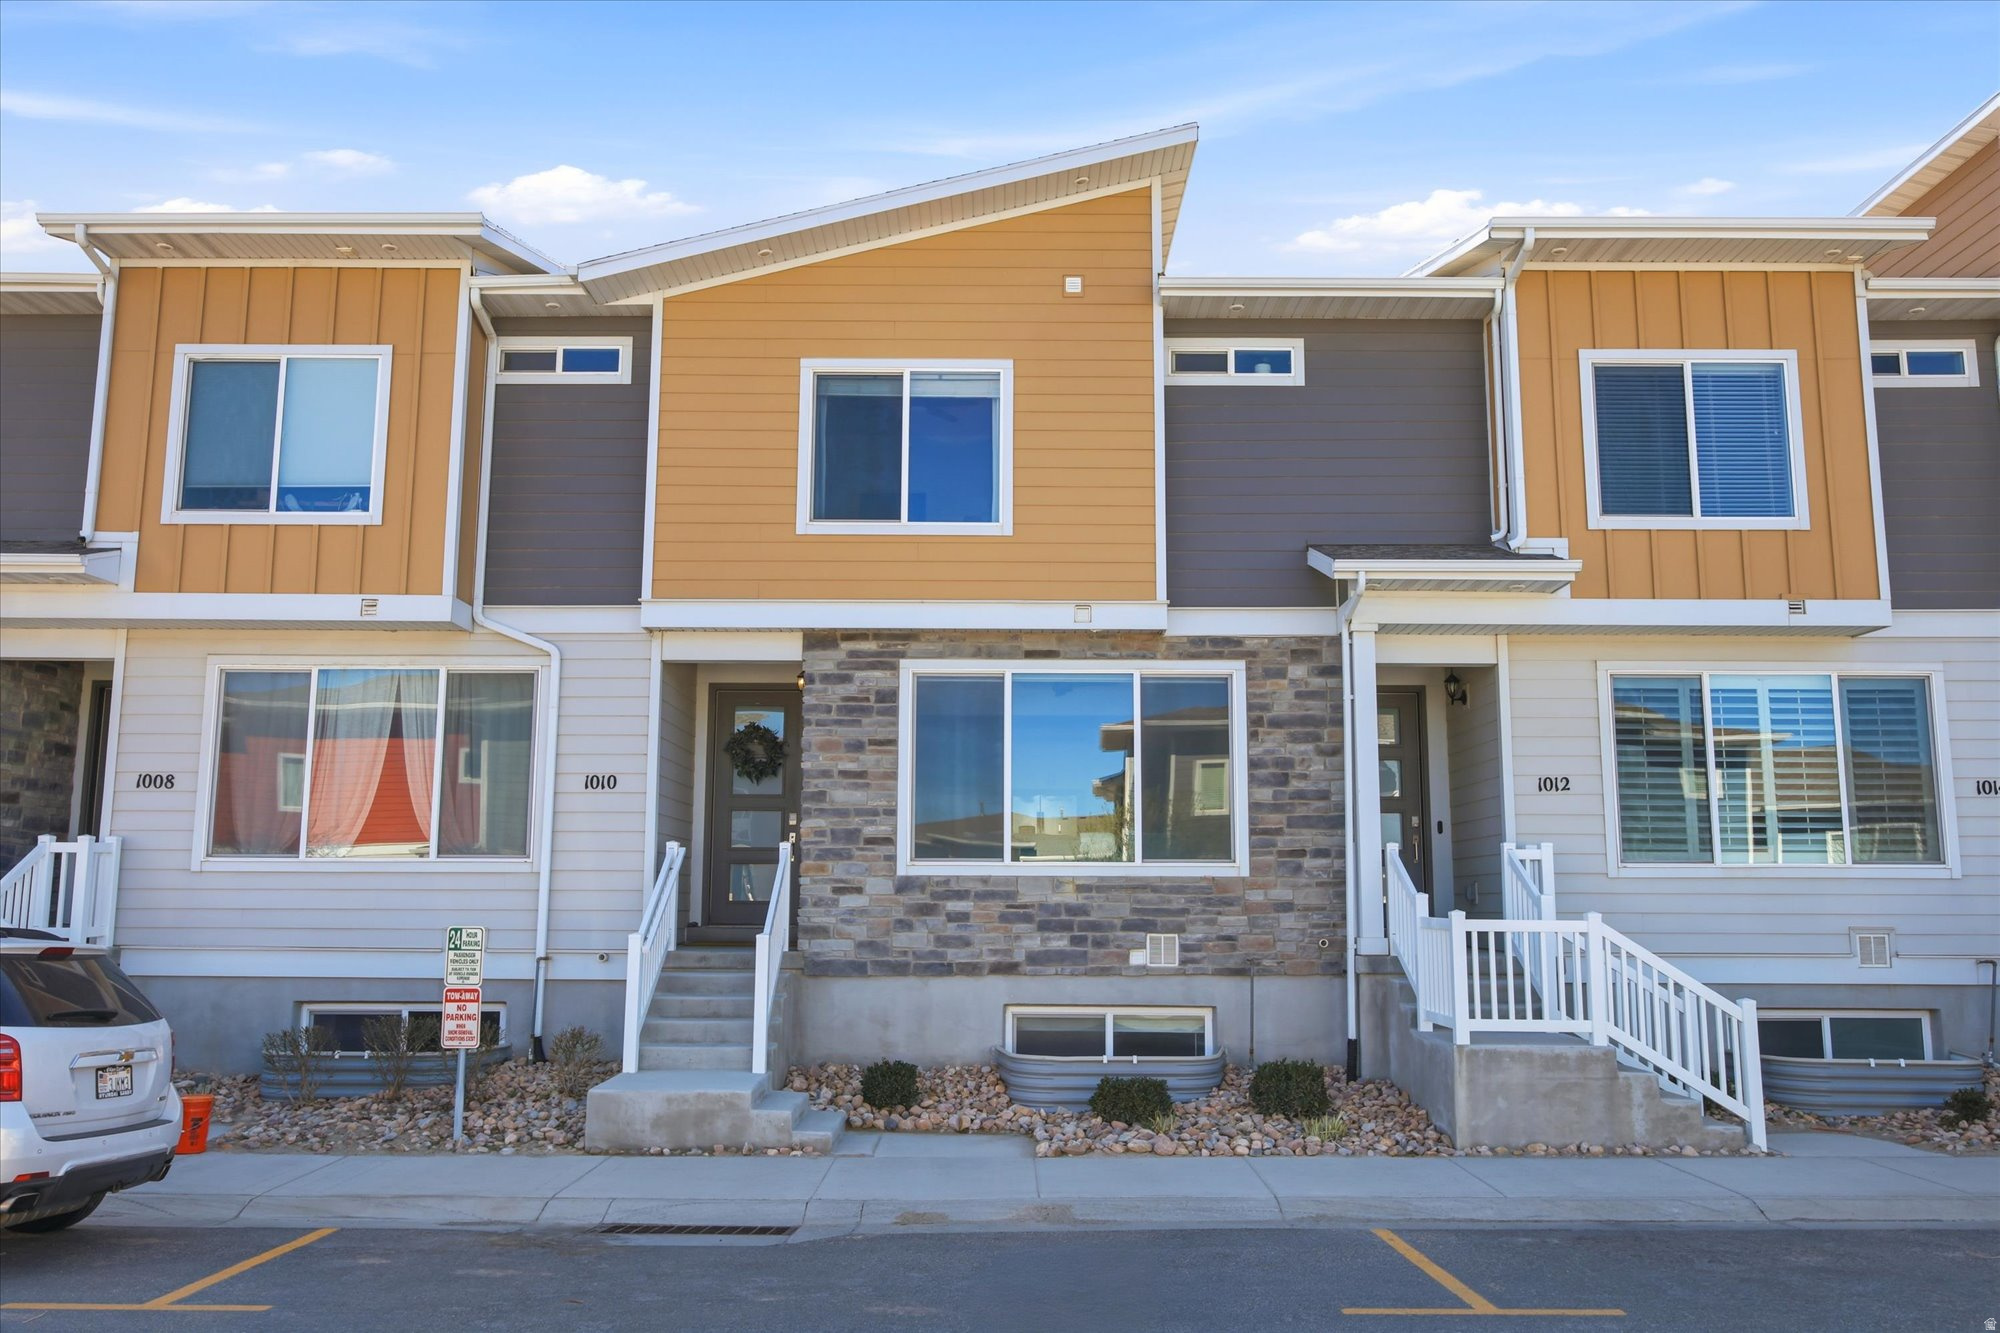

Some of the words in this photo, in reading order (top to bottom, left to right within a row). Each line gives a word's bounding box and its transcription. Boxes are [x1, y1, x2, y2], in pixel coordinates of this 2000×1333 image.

[136, 773, 175, 789] 1008
[585, 774, 617, 790] 1010
[1538, 776, 1570, 792] 1012
[1976, 780, 2000, 795] 101
[449, 930, 461, 949] 24
[462, 940, 480, 948] PARKING
[446, 991, 479, 1000] TOW-AWAY
[456, 1004, 467, 1012] NO
[446, 1013, 477, 1021] PARKING
